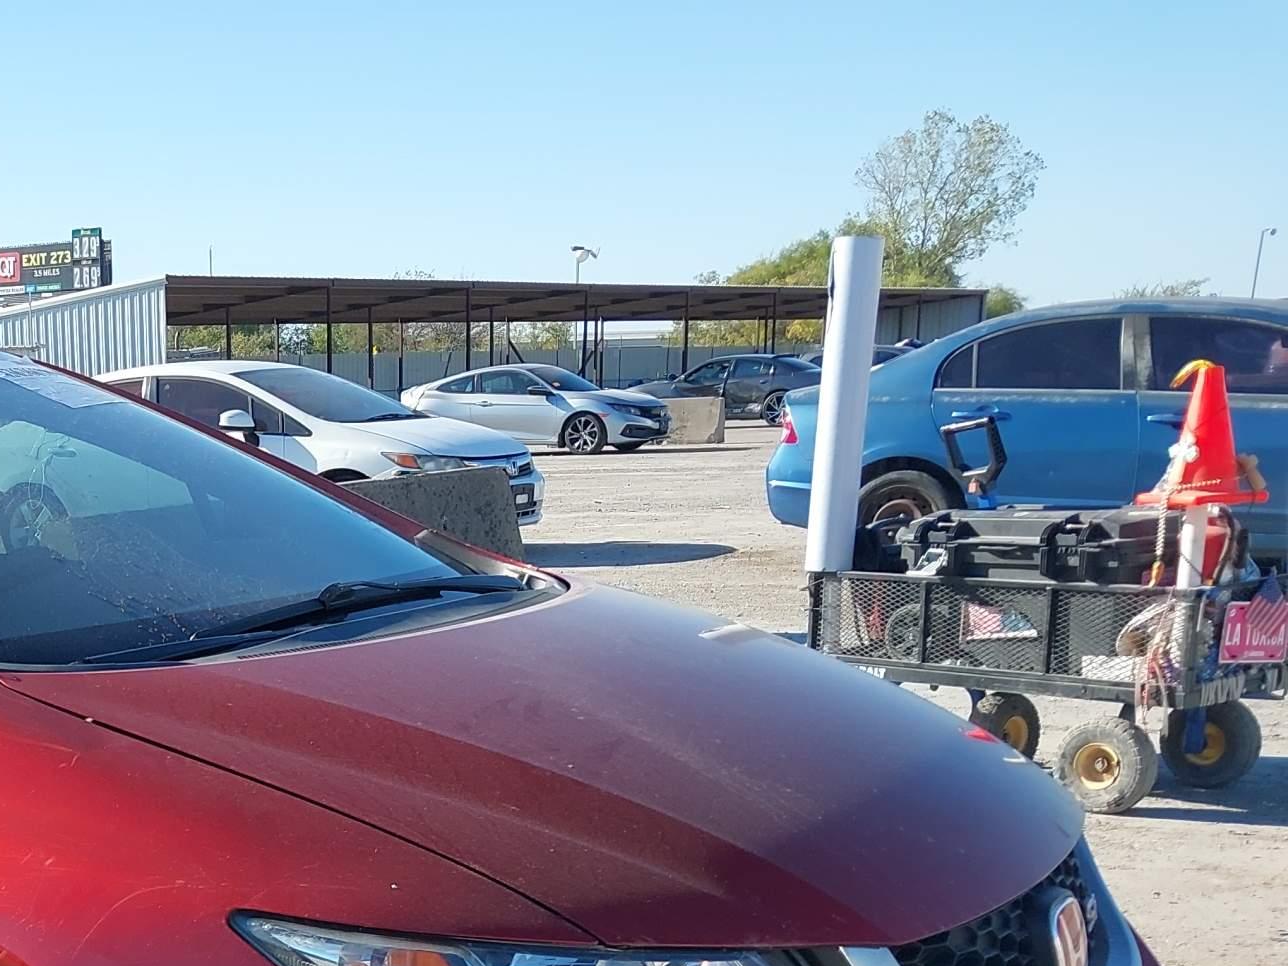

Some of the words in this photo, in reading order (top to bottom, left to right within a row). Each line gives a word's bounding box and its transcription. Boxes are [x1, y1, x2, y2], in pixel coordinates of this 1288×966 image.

[22, 252, 47, 267] EXIT
[49, 250, 71, 264] 273
[1224, 623, 1241, 646] LA
